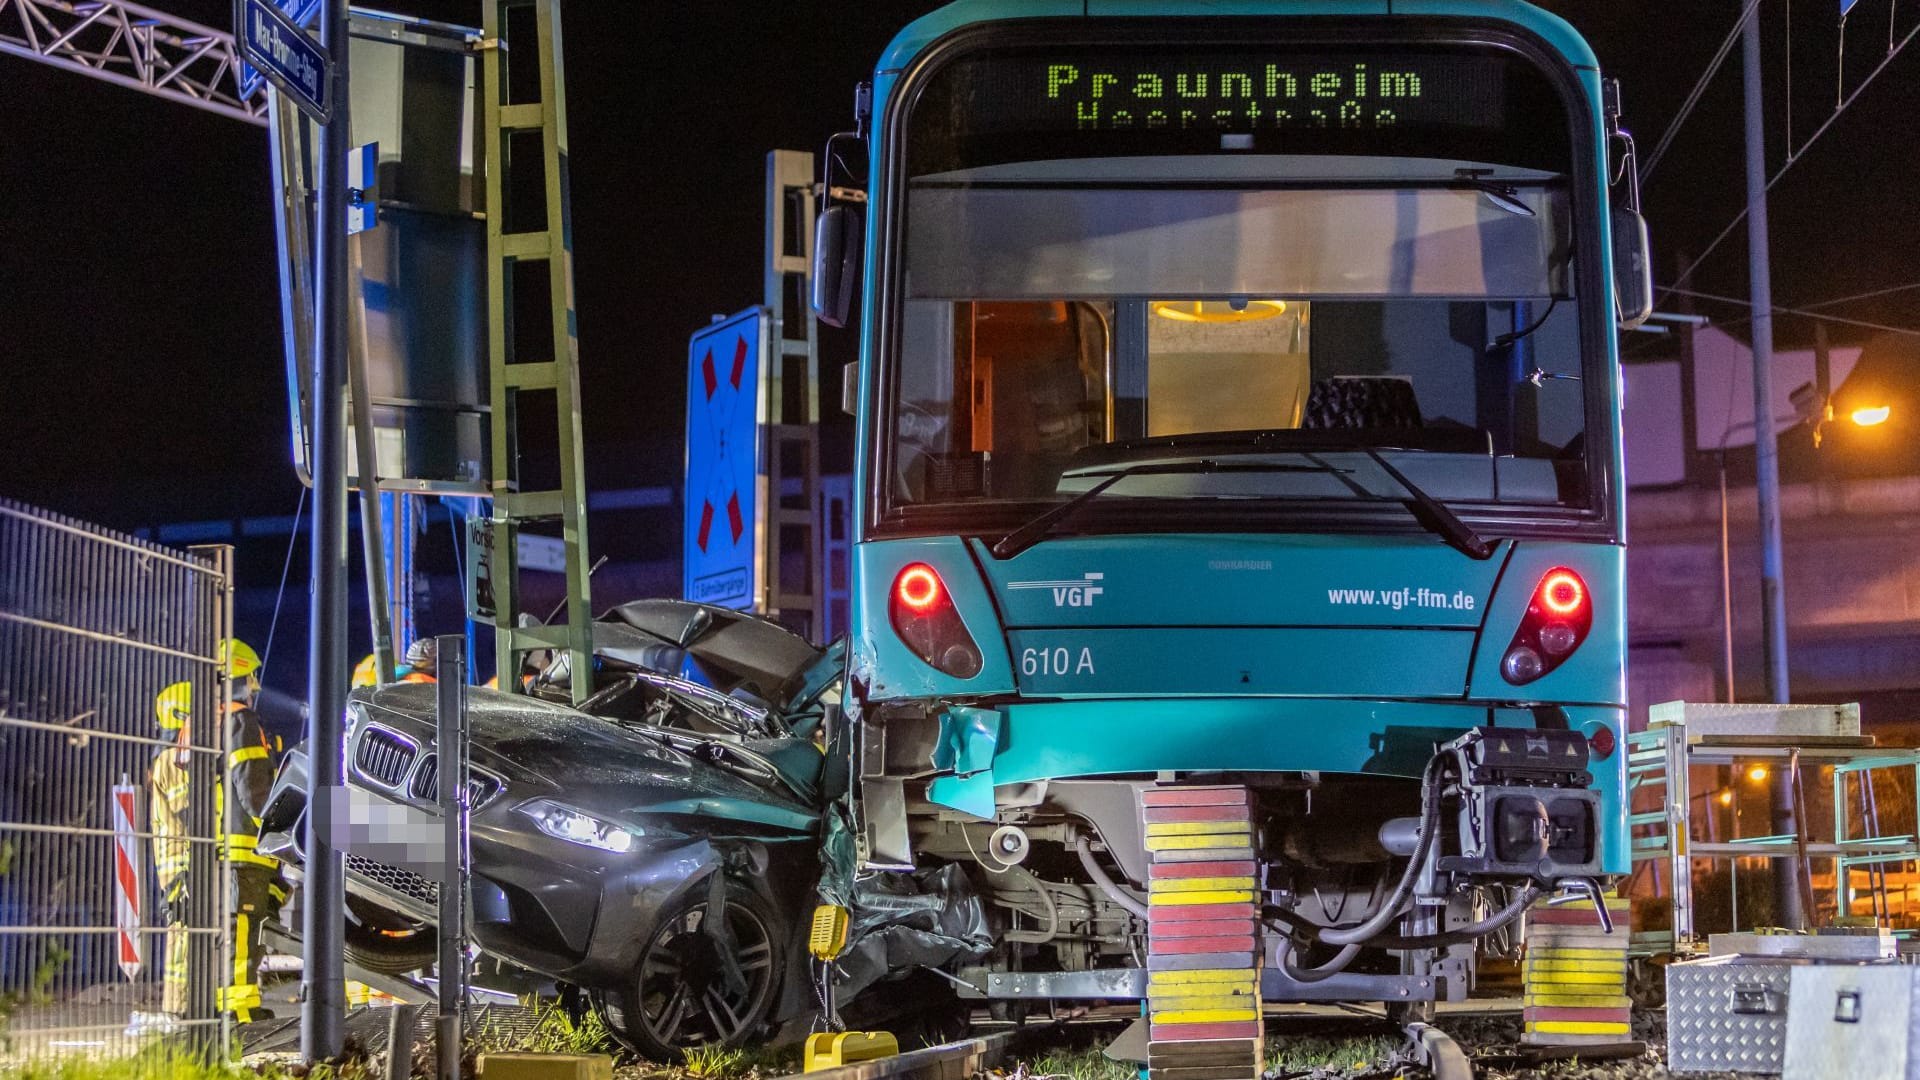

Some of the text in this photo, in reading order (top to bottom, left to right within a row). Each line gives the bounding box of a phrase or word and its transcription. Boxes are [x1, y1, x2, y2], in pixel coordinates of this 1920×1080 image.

[1047, 64, 1421, 98] Praunheim
[1053, 572, 1104, 606] VGF
[1327, 587, 1475, 610] www.vgf-ffm.de
[1022, 647, 1095, 676] 610 A
